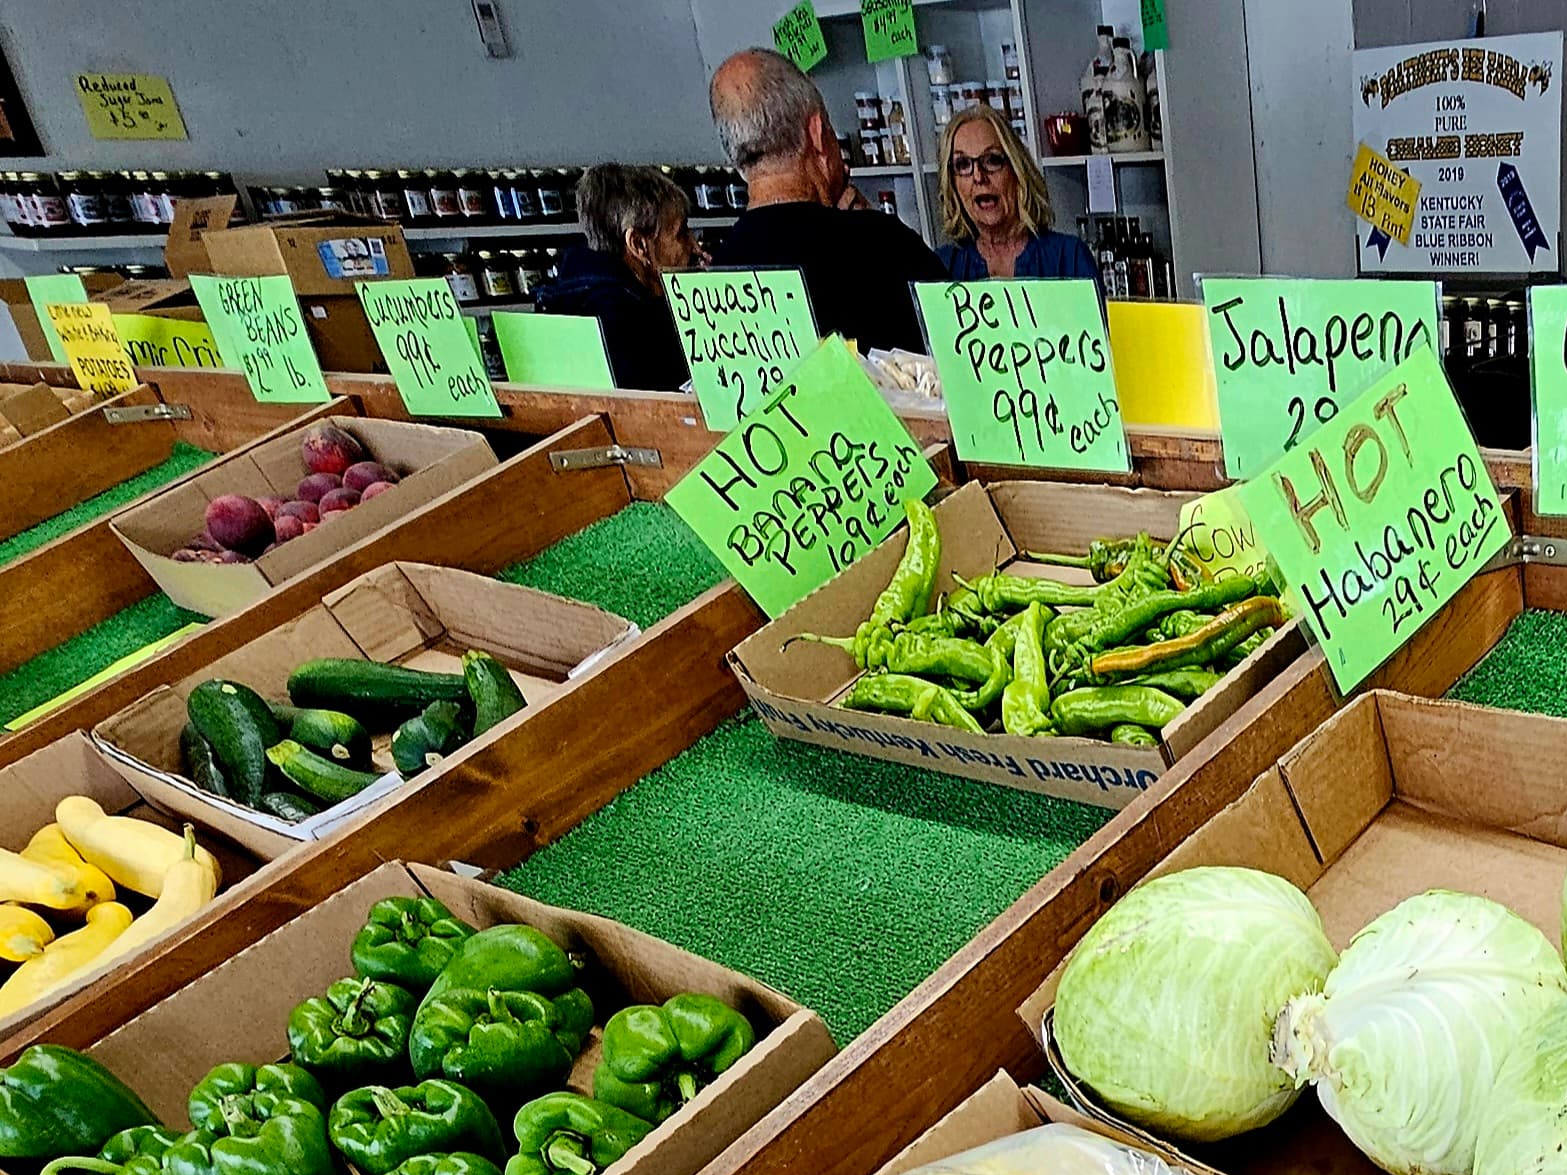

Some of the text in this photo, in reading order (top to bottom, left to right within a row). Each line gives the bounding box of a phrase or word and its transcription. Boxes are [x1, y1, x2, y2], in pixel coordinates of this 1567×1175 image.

[1486, 50, 1529, 101] FARM
[1436, 95, 1466, 112] 100%
[1435, 115, 1467, 132] PURE
[1464, 132, 1524, 158] HONEY
[1369, 157, 1406, 189] HONEY
[1438, 167, 1464, 182] 2019
[1360, 171, 1410, 214] All Flavors
[1420, 195, 1484, 212] KENTUCKY
[1381, 212, 1405, 239] Pint
[1421, 214, 1486, 230] STATE FAIR
[1415, 233, 1493, 248] BLUE RIBBON
[1430, 251, 1480, 266] WINNER!
[218, 280, 265, 316] GREEN
[361, 284, 455, 329] Cucumbers
[670, 269, 778, 331] Squash
[945, 282, 1038, 340] Bell
[244, 305, 298, 347] BEANS
[685, 317, 800, 366] Zucchini
[77, 357, 131, 381] POTATOES
[283, 354, 311, 389] lb.
[448, 366, 488, 401] each
[993, 389, 1119, 461] 99¢ each
[700, 384, 808, 511] HOT
[1272, 383, 1415, 555] HOT
[1301, 453, 1477, 640] Habanero
[1445, 493, 1494, 570] each
[806, 713, 940, 760] Kentucky
[940, 742, 1024, 777] Fresh
